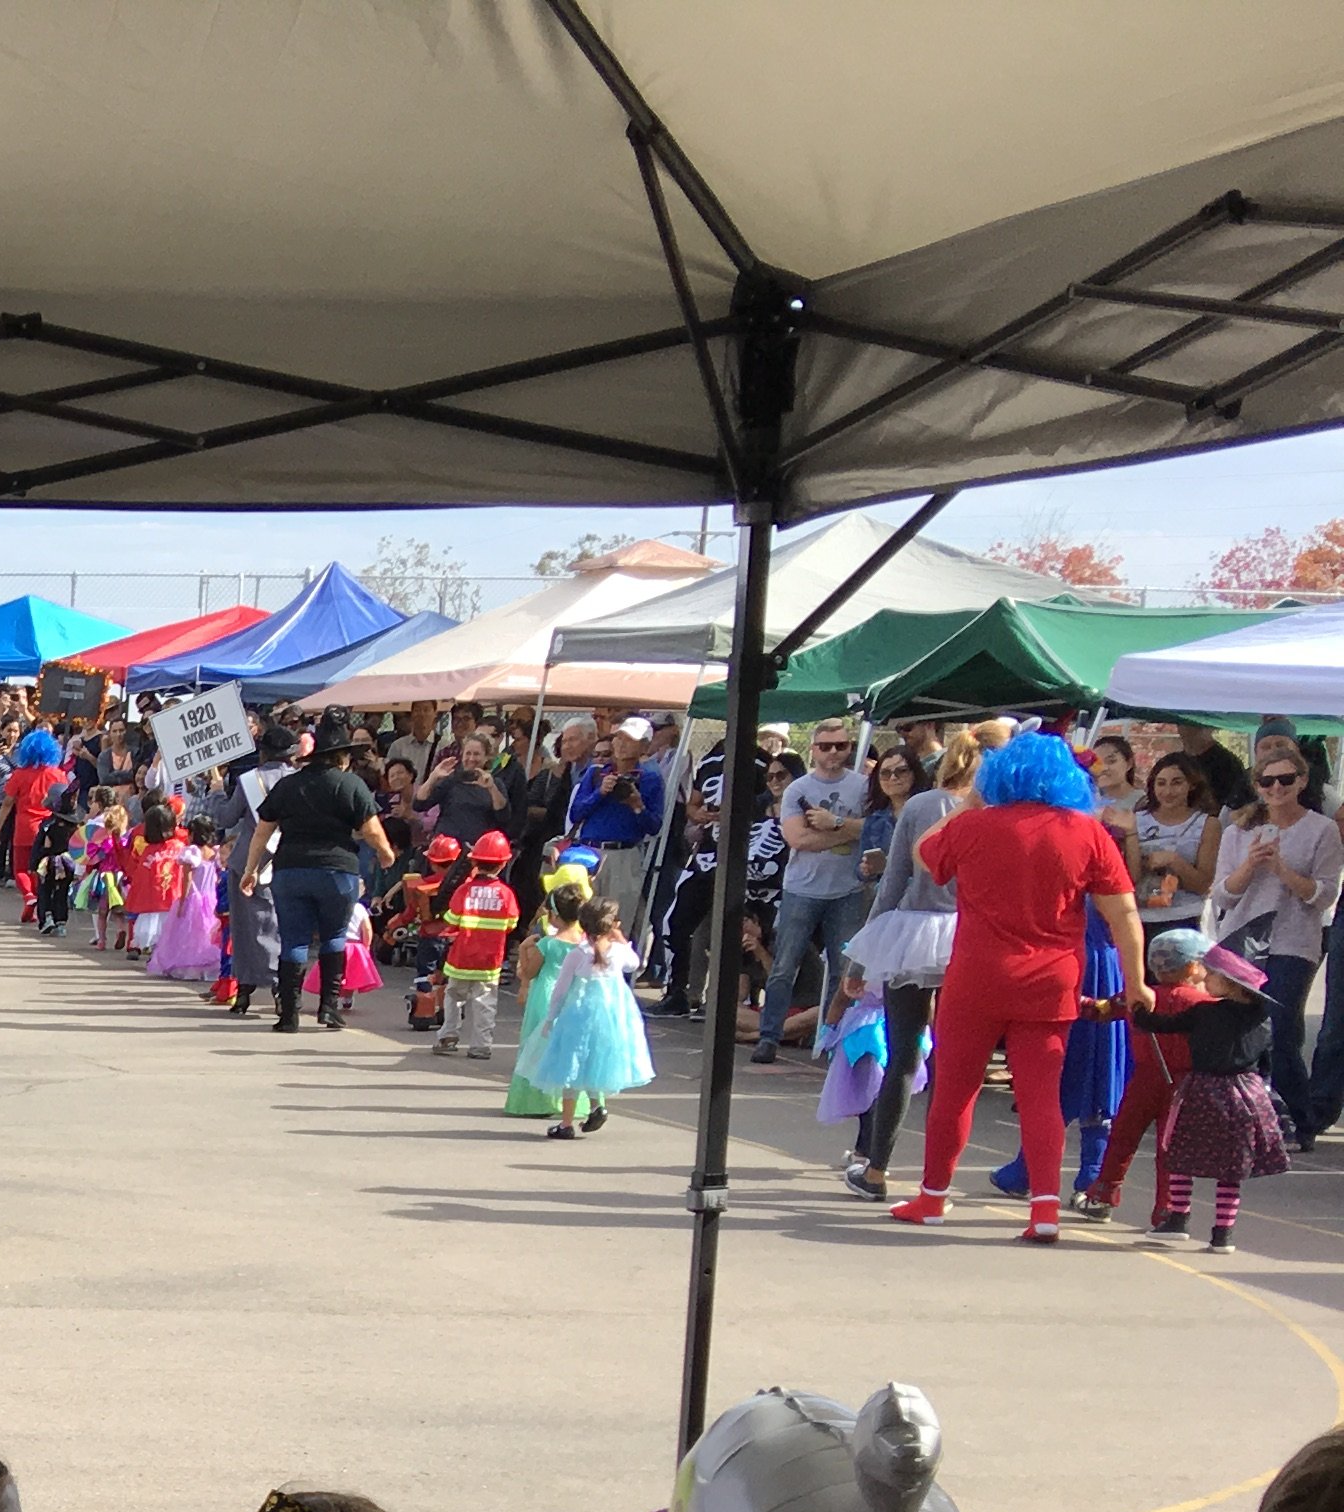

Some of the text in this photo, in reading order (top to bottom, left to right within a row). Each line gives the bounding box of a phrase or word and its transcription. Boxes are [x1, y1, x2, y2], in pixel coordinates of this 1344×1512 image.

[179, 702, 216, 731] 1920
[183, 721, 224, 749] WOMEN
[174, 732, 243, 771] GET THE VOTE
[465, 897, 504, 911] CHIEF
[470, 885, 501, 898] FIRE
